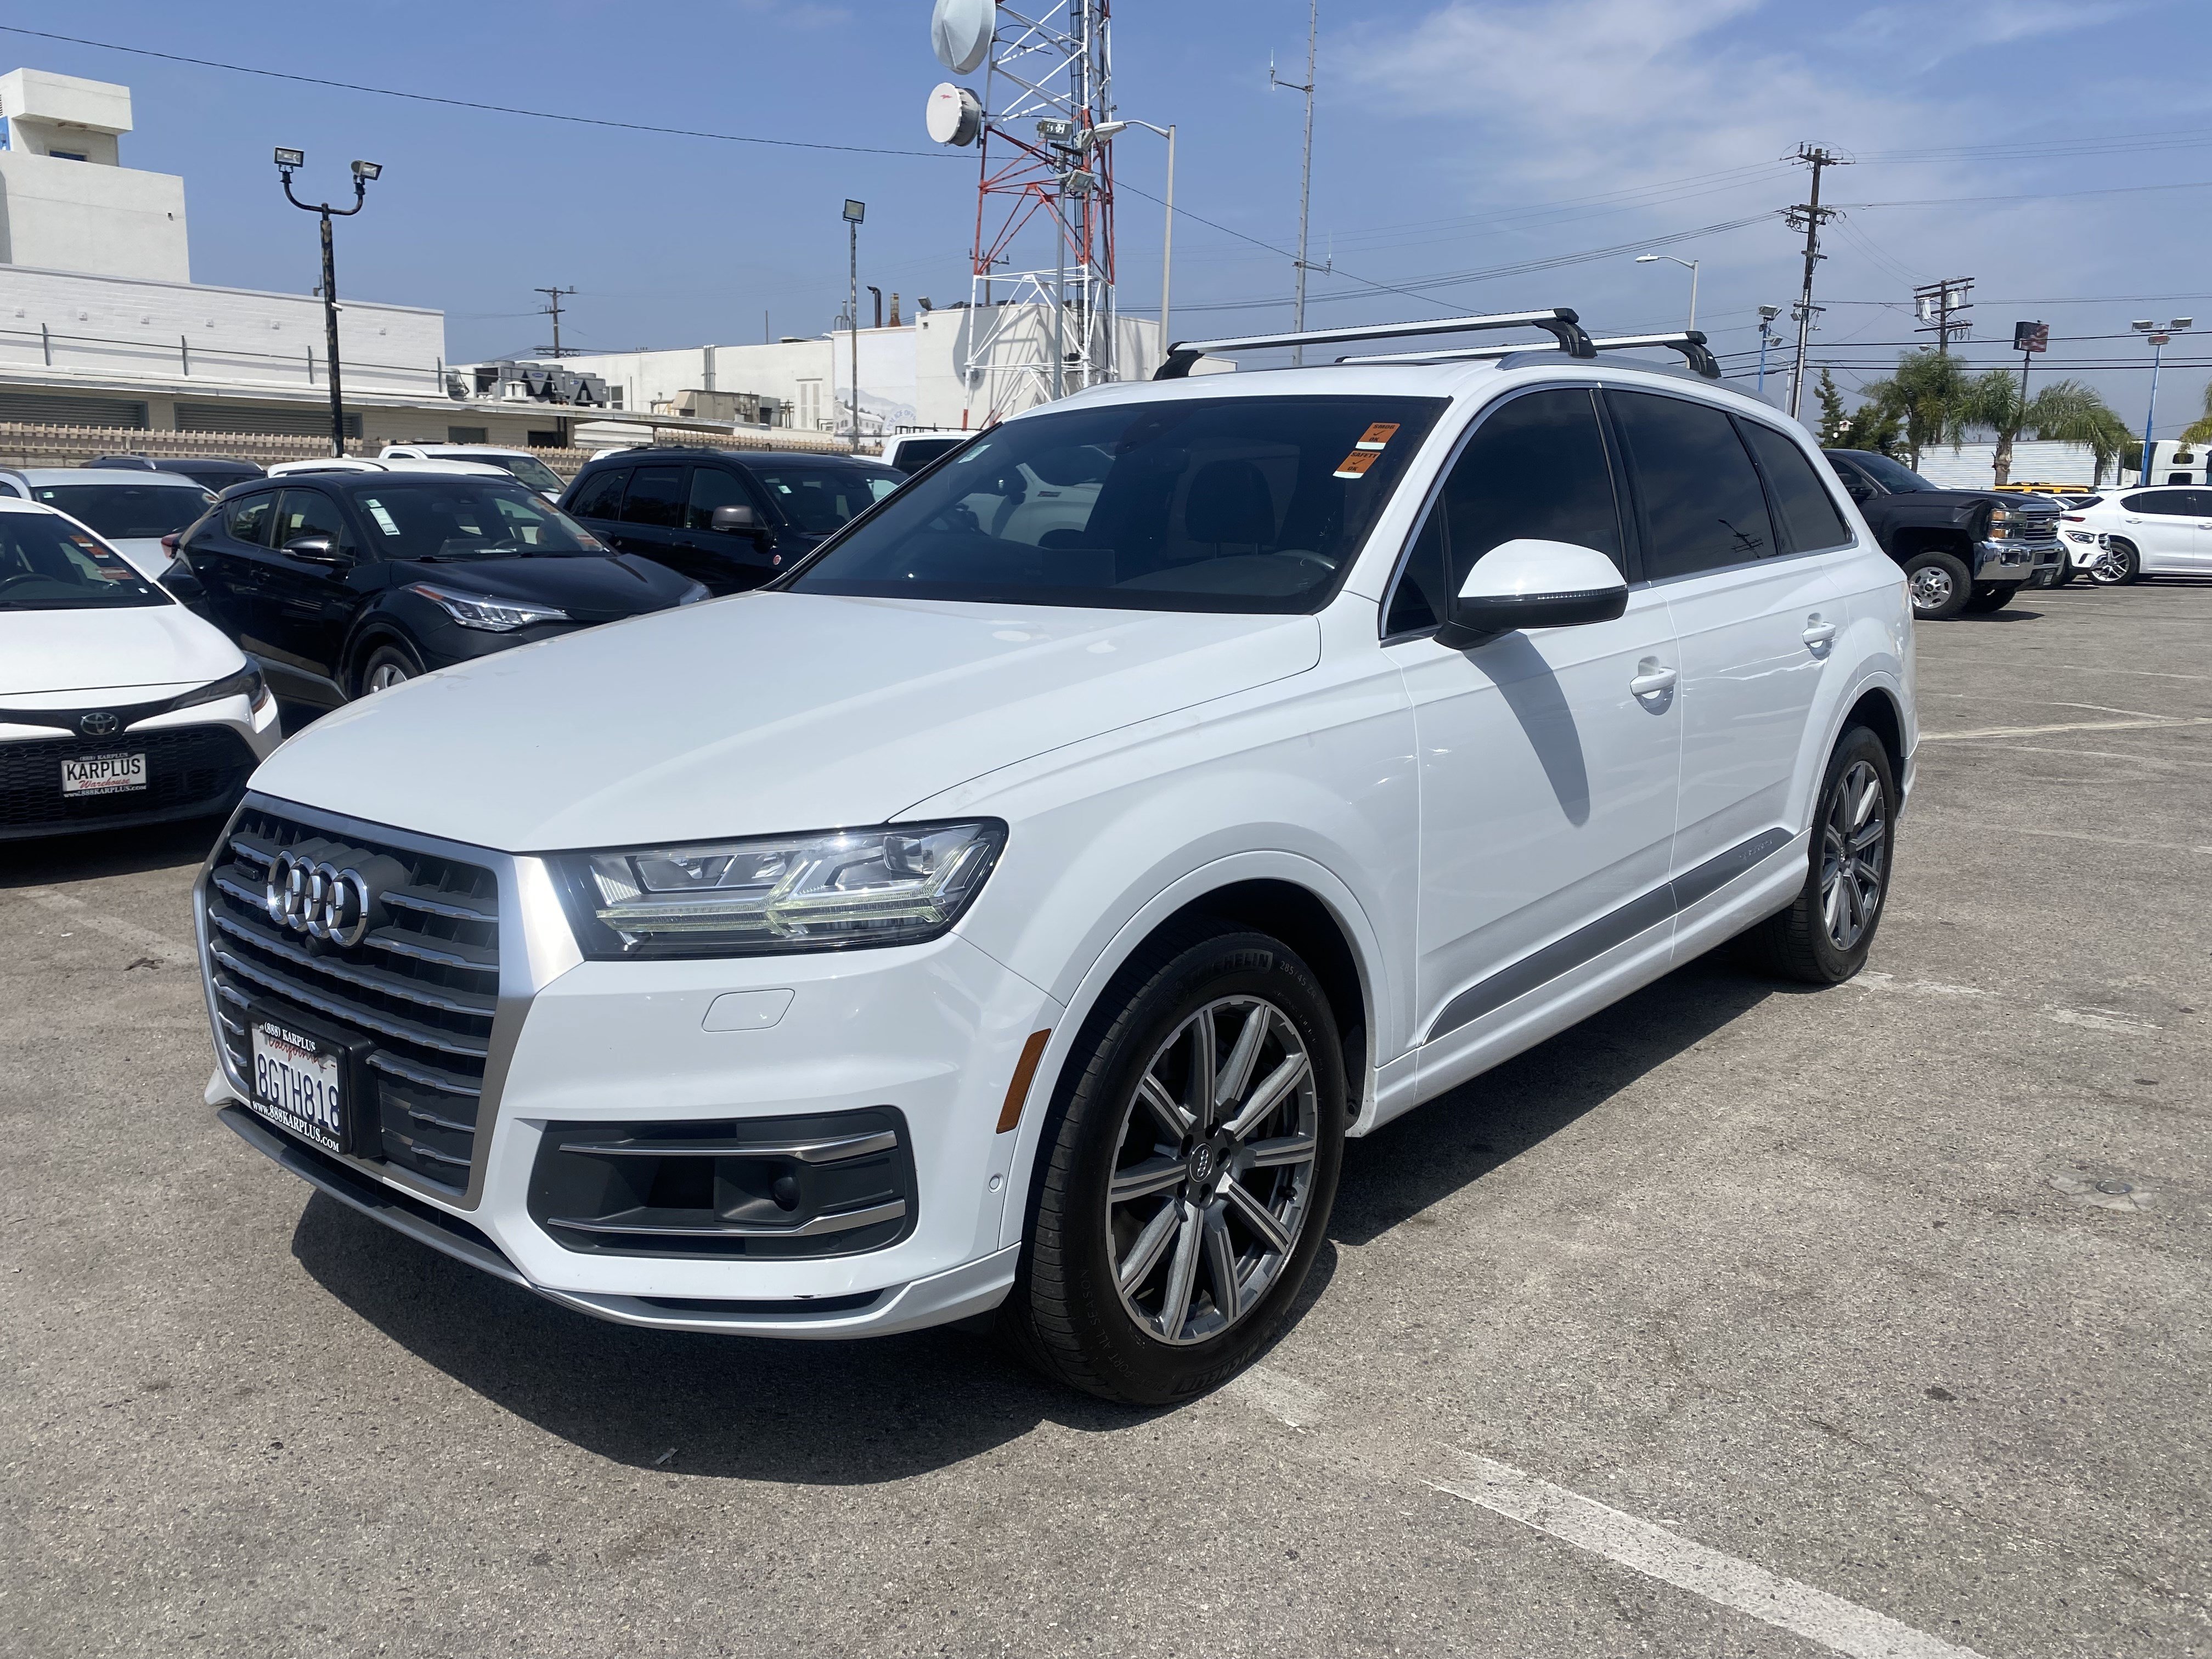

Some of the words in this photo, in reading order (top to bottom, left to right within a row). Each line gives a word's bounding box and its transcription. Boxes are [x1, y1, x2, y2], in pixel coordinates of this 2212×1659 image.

[887, 410, 904, 431] POLICE
[66, 758, 140, 781] KARPLUS
[78, 777, 131, 789] Warehouse
[264, 1021, 281, 1037] (888)
[282, 1029, 316, 1052] KARPLUS
[257, 1053, 340, 1132] 8GTH818
[1080, 1269, 1101, 1326] SEASON
[1096, 1328, 1115, 1350] ALL
